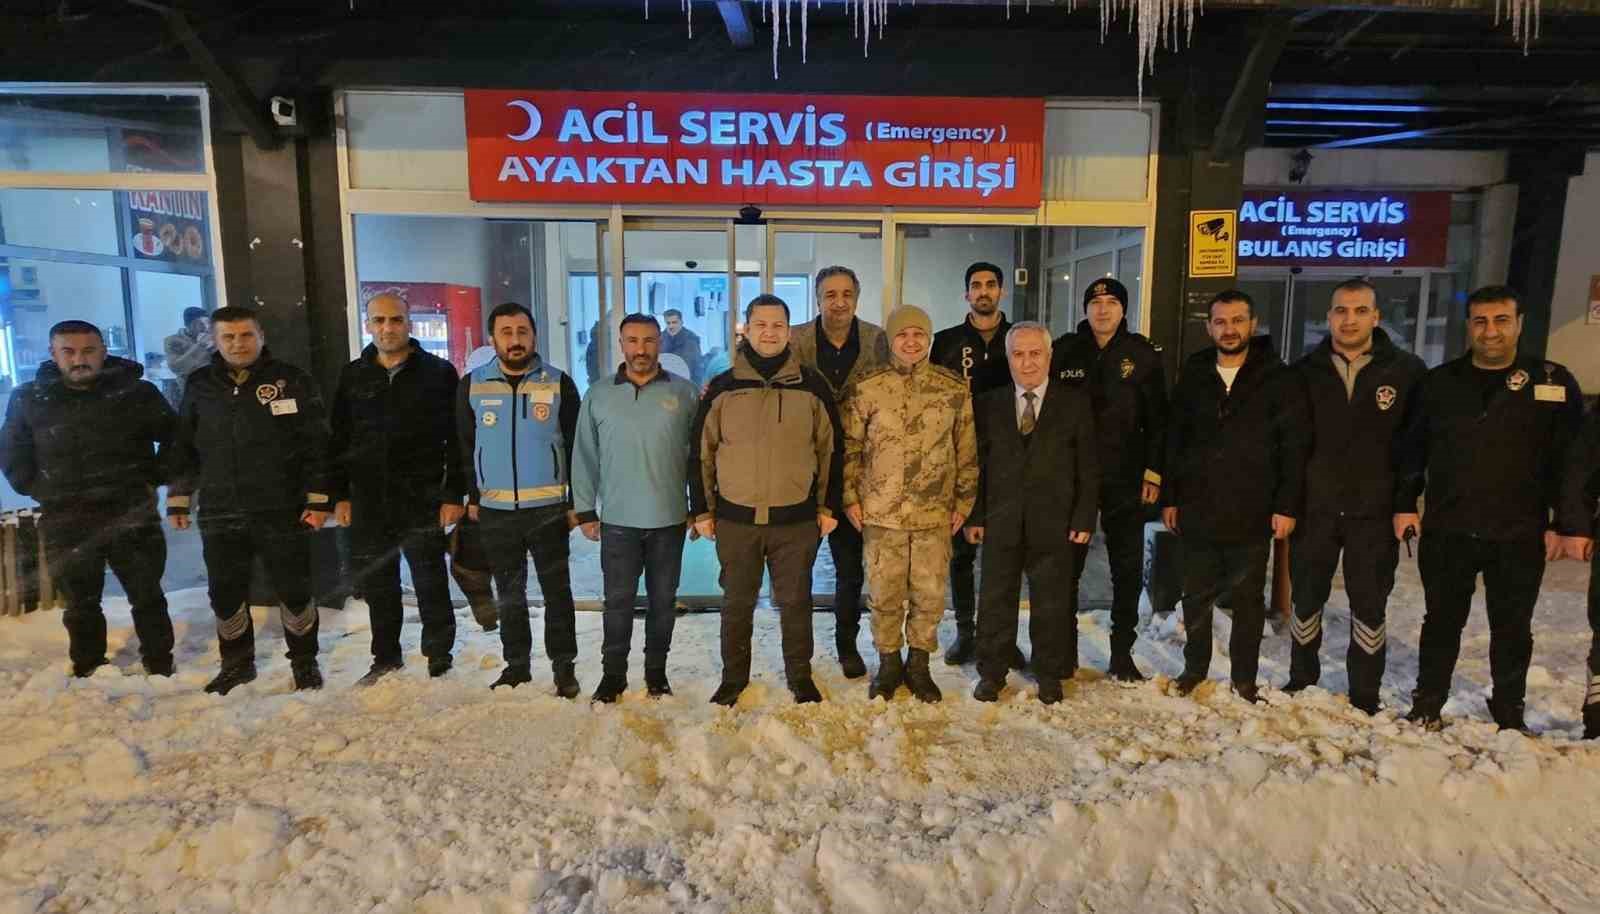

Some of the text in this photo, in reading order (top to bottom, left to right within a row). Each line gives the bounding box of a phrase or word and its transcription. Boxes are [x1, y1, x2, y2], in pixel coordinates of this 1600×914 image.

[557, 102, 668, 143] ACİL
[680, 104, 847, 146] SERVİS
[497, 155, 1017, 197] AYAKTAN HASTA GİRİŞİ
[1239, 196, 1405, 224] ACİL SERVİS
[1238, 238, 1406, 262] BULANS GİRİŞİ
